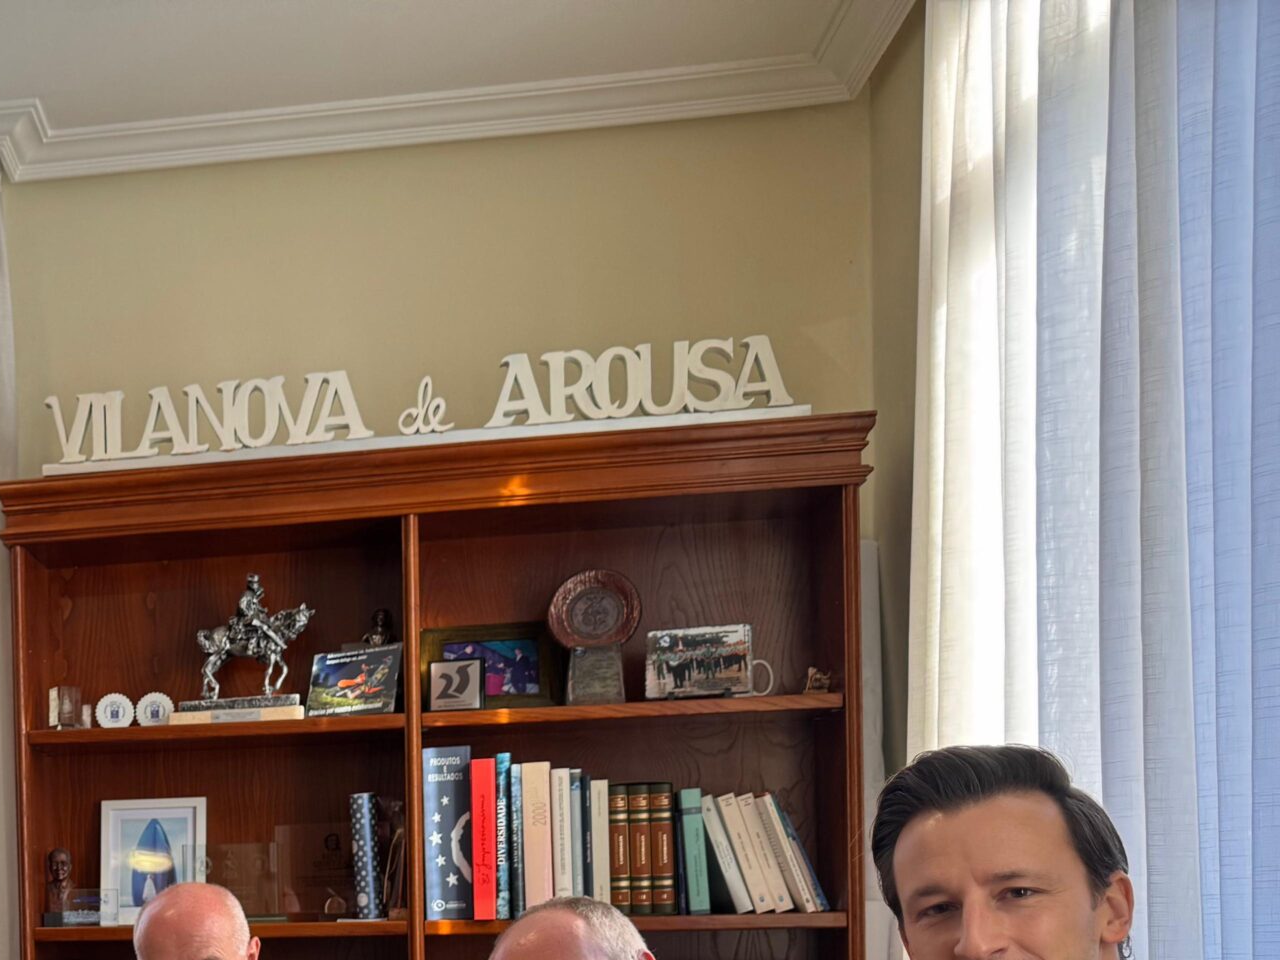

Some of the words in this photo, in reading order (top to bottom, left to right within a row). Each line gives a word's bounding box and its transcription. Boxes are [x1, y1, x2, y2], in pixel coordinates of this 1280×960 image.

[45, 369, 375, 463] VILANOVA
[397, 374, 455, 436] de
[484, 333, 796, 429] AROUSA
[428, 772, 463, 782] RESULTADOS
[430, 756, 460, 768] PRODUTOS
[496, 798, 507, 865] DIVERSIDADE
